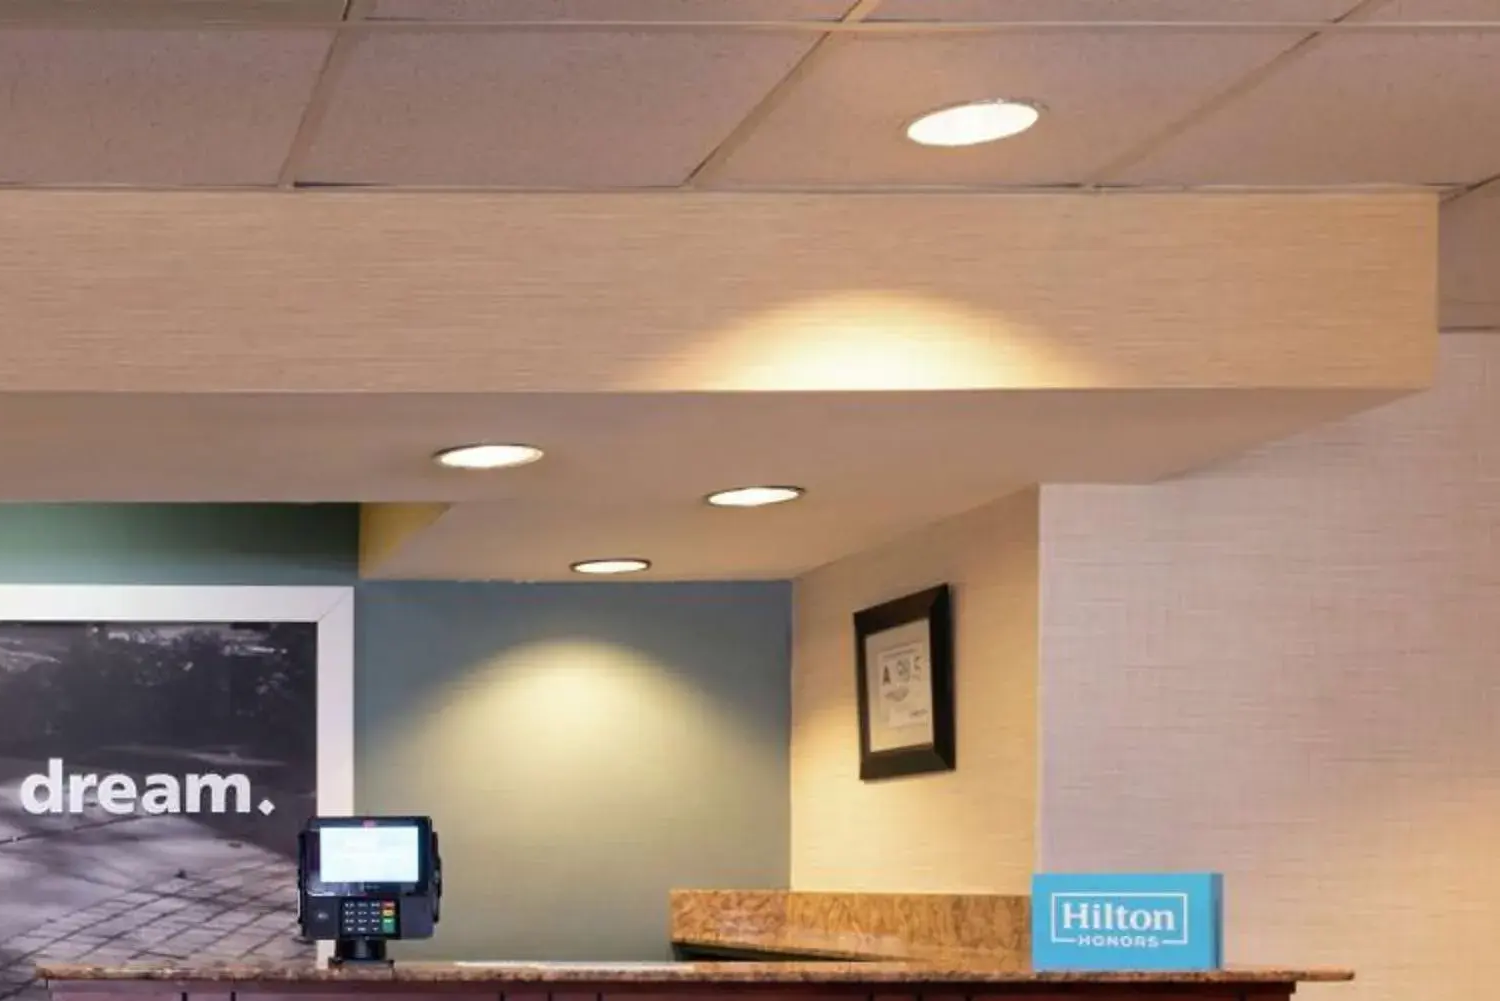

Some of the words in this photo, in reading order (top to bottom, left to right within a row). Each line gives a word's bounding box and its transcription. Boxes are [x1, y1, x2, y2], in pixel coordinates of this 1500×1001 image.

[19, 757, 276, 816] dream.
[1062, 902, 1176, 931] Hilton
[1077, 934, 1160, 948] HONORS
